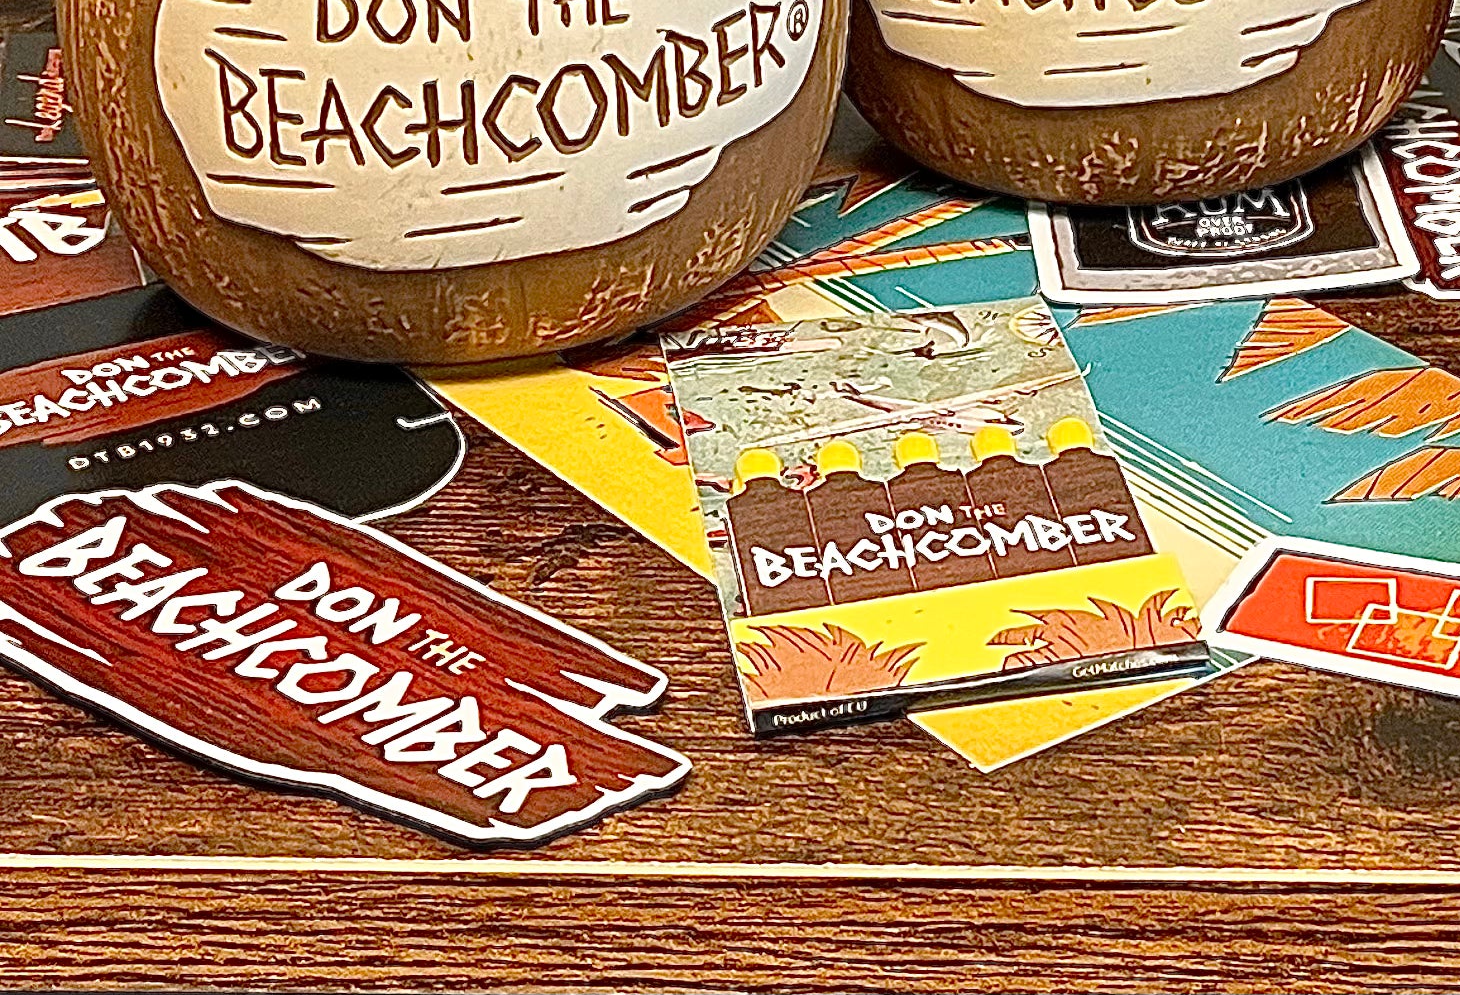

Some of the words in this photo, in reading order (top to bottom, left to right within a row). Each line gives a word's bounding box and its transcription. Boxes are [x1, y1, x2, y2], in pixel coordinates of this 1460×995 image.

[61, 354, 150, 384] DON
[154, 347, 195, 362] THE
[68, 397, 321, 470] DTB1932.COM
[750, 509, 1137, 588] BEACHCOMBER
[864, 504, 954, 534] DON
[959, 502, 1007, 520] THE
[273, 561, 420, 646] DON
[406, 629, 487, 677] THE
[18, 514, 578, 815] BEACHCOMBER
